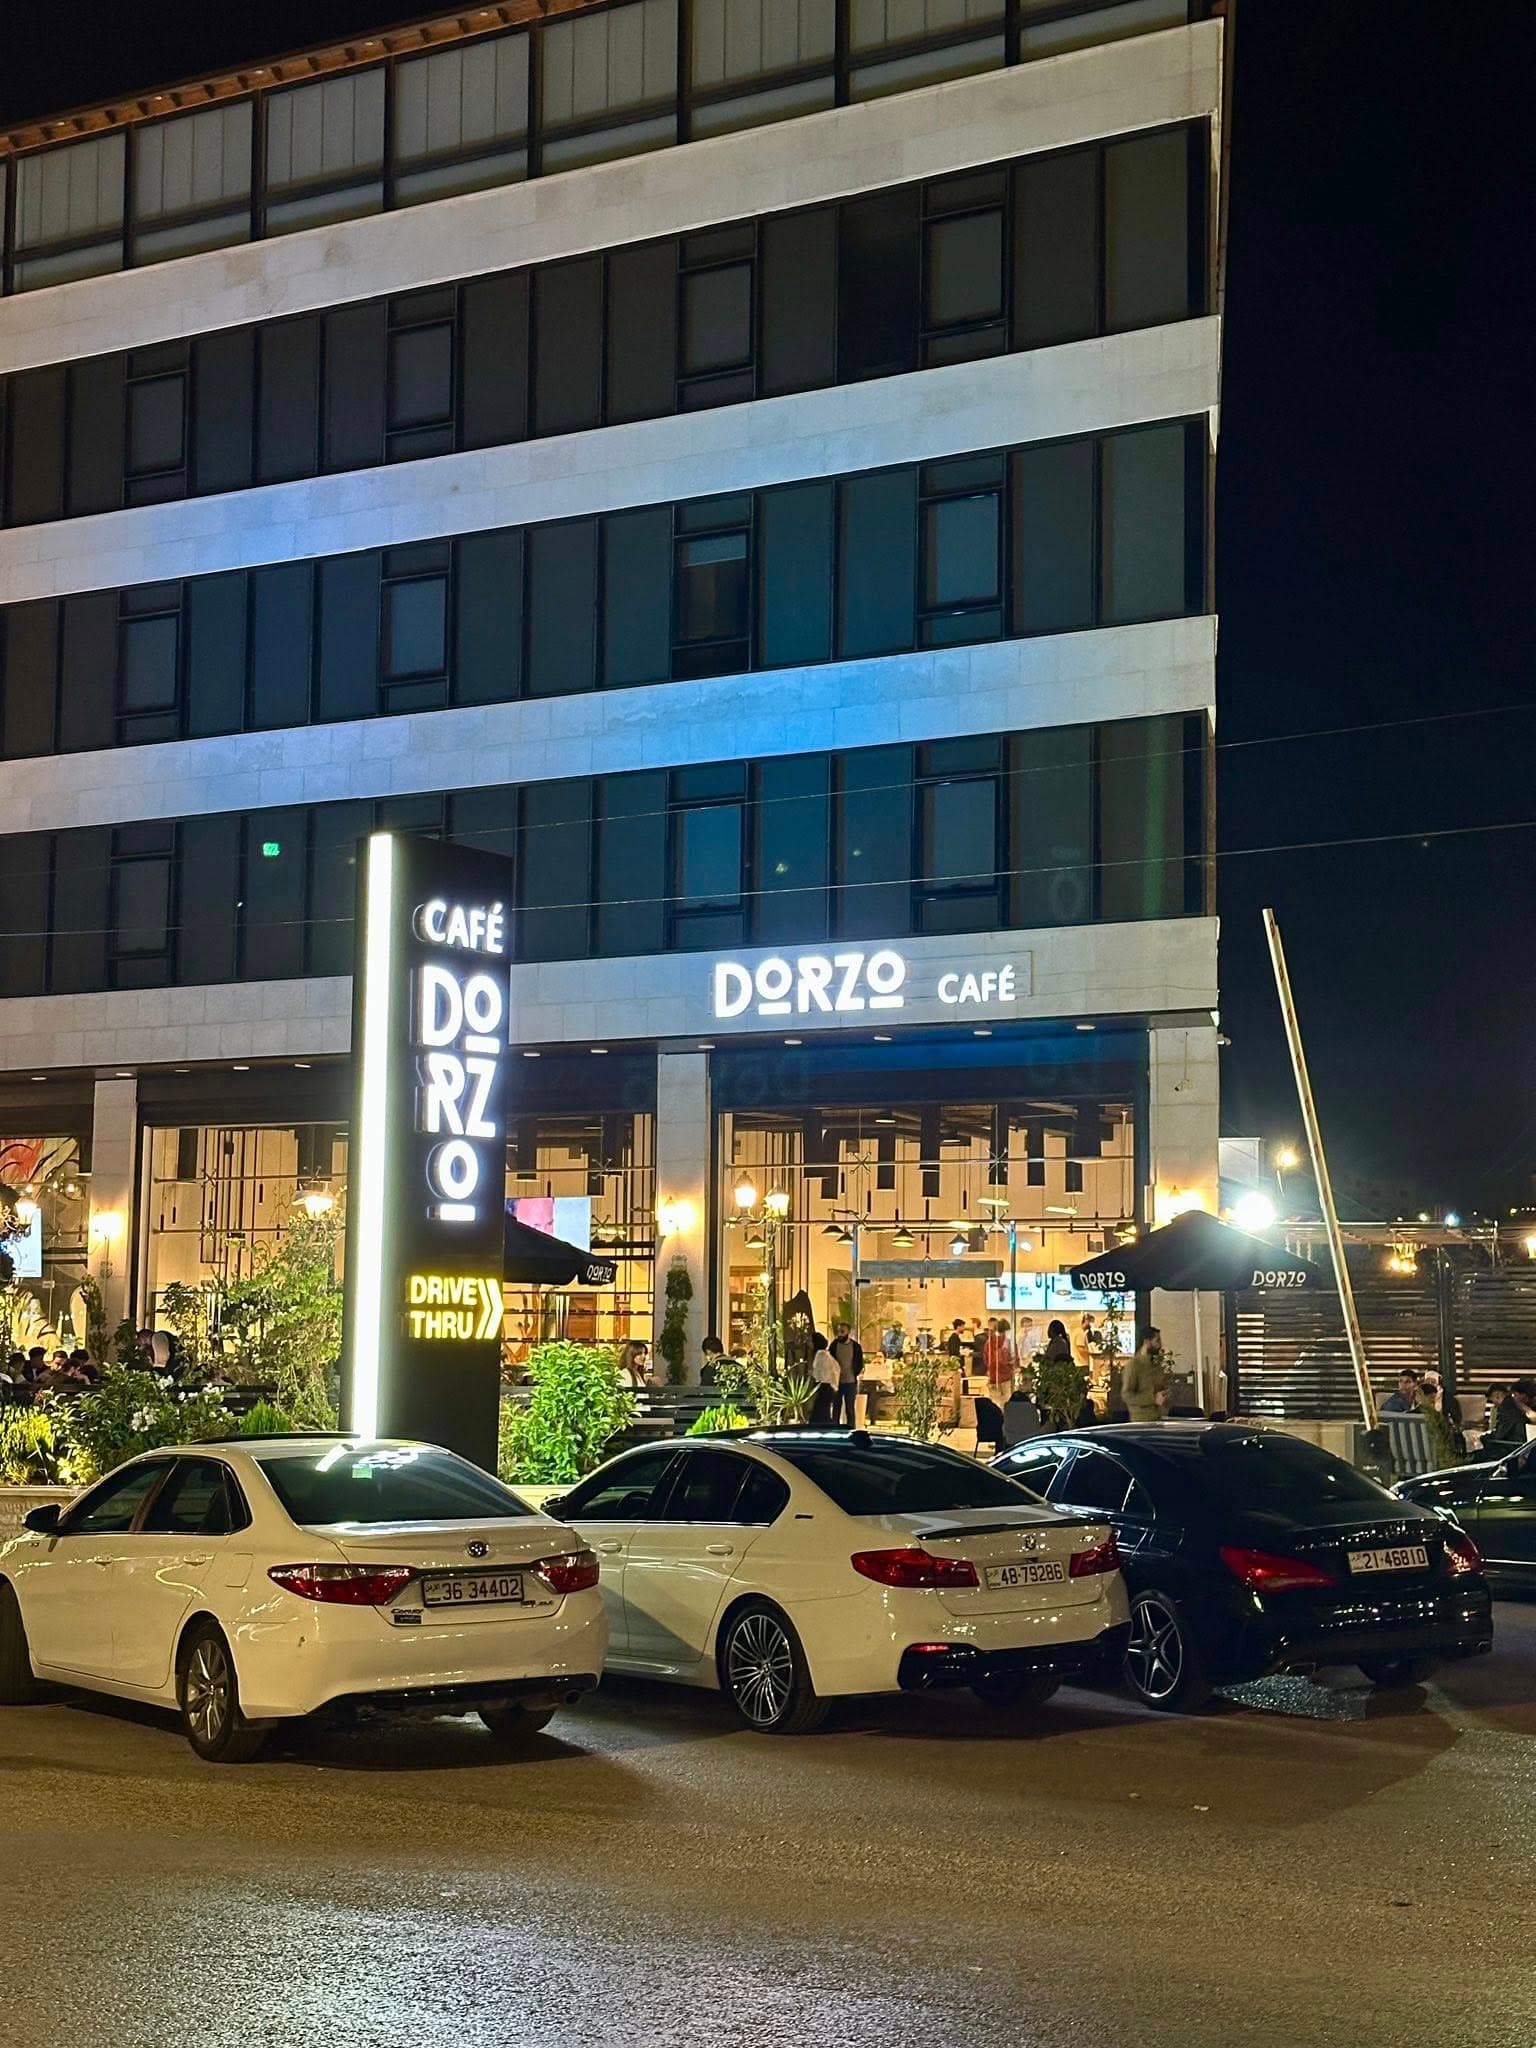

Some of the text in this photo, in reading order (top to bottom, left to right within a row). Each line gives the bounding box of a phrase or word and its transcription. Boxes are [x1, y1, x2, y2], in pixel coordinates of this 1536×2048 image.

[424, 900, 504, 954] CAFÉ
[715, 951, 1016, 1018] DORZO CAFÉ
[410, 1275, 478, 1306] DRIVE
[1079, 1271, 1126, 1289] DORZO
[1251, 1270, 1307, 1288] DORZO
[409, 1310, 474, 1339] THRU
